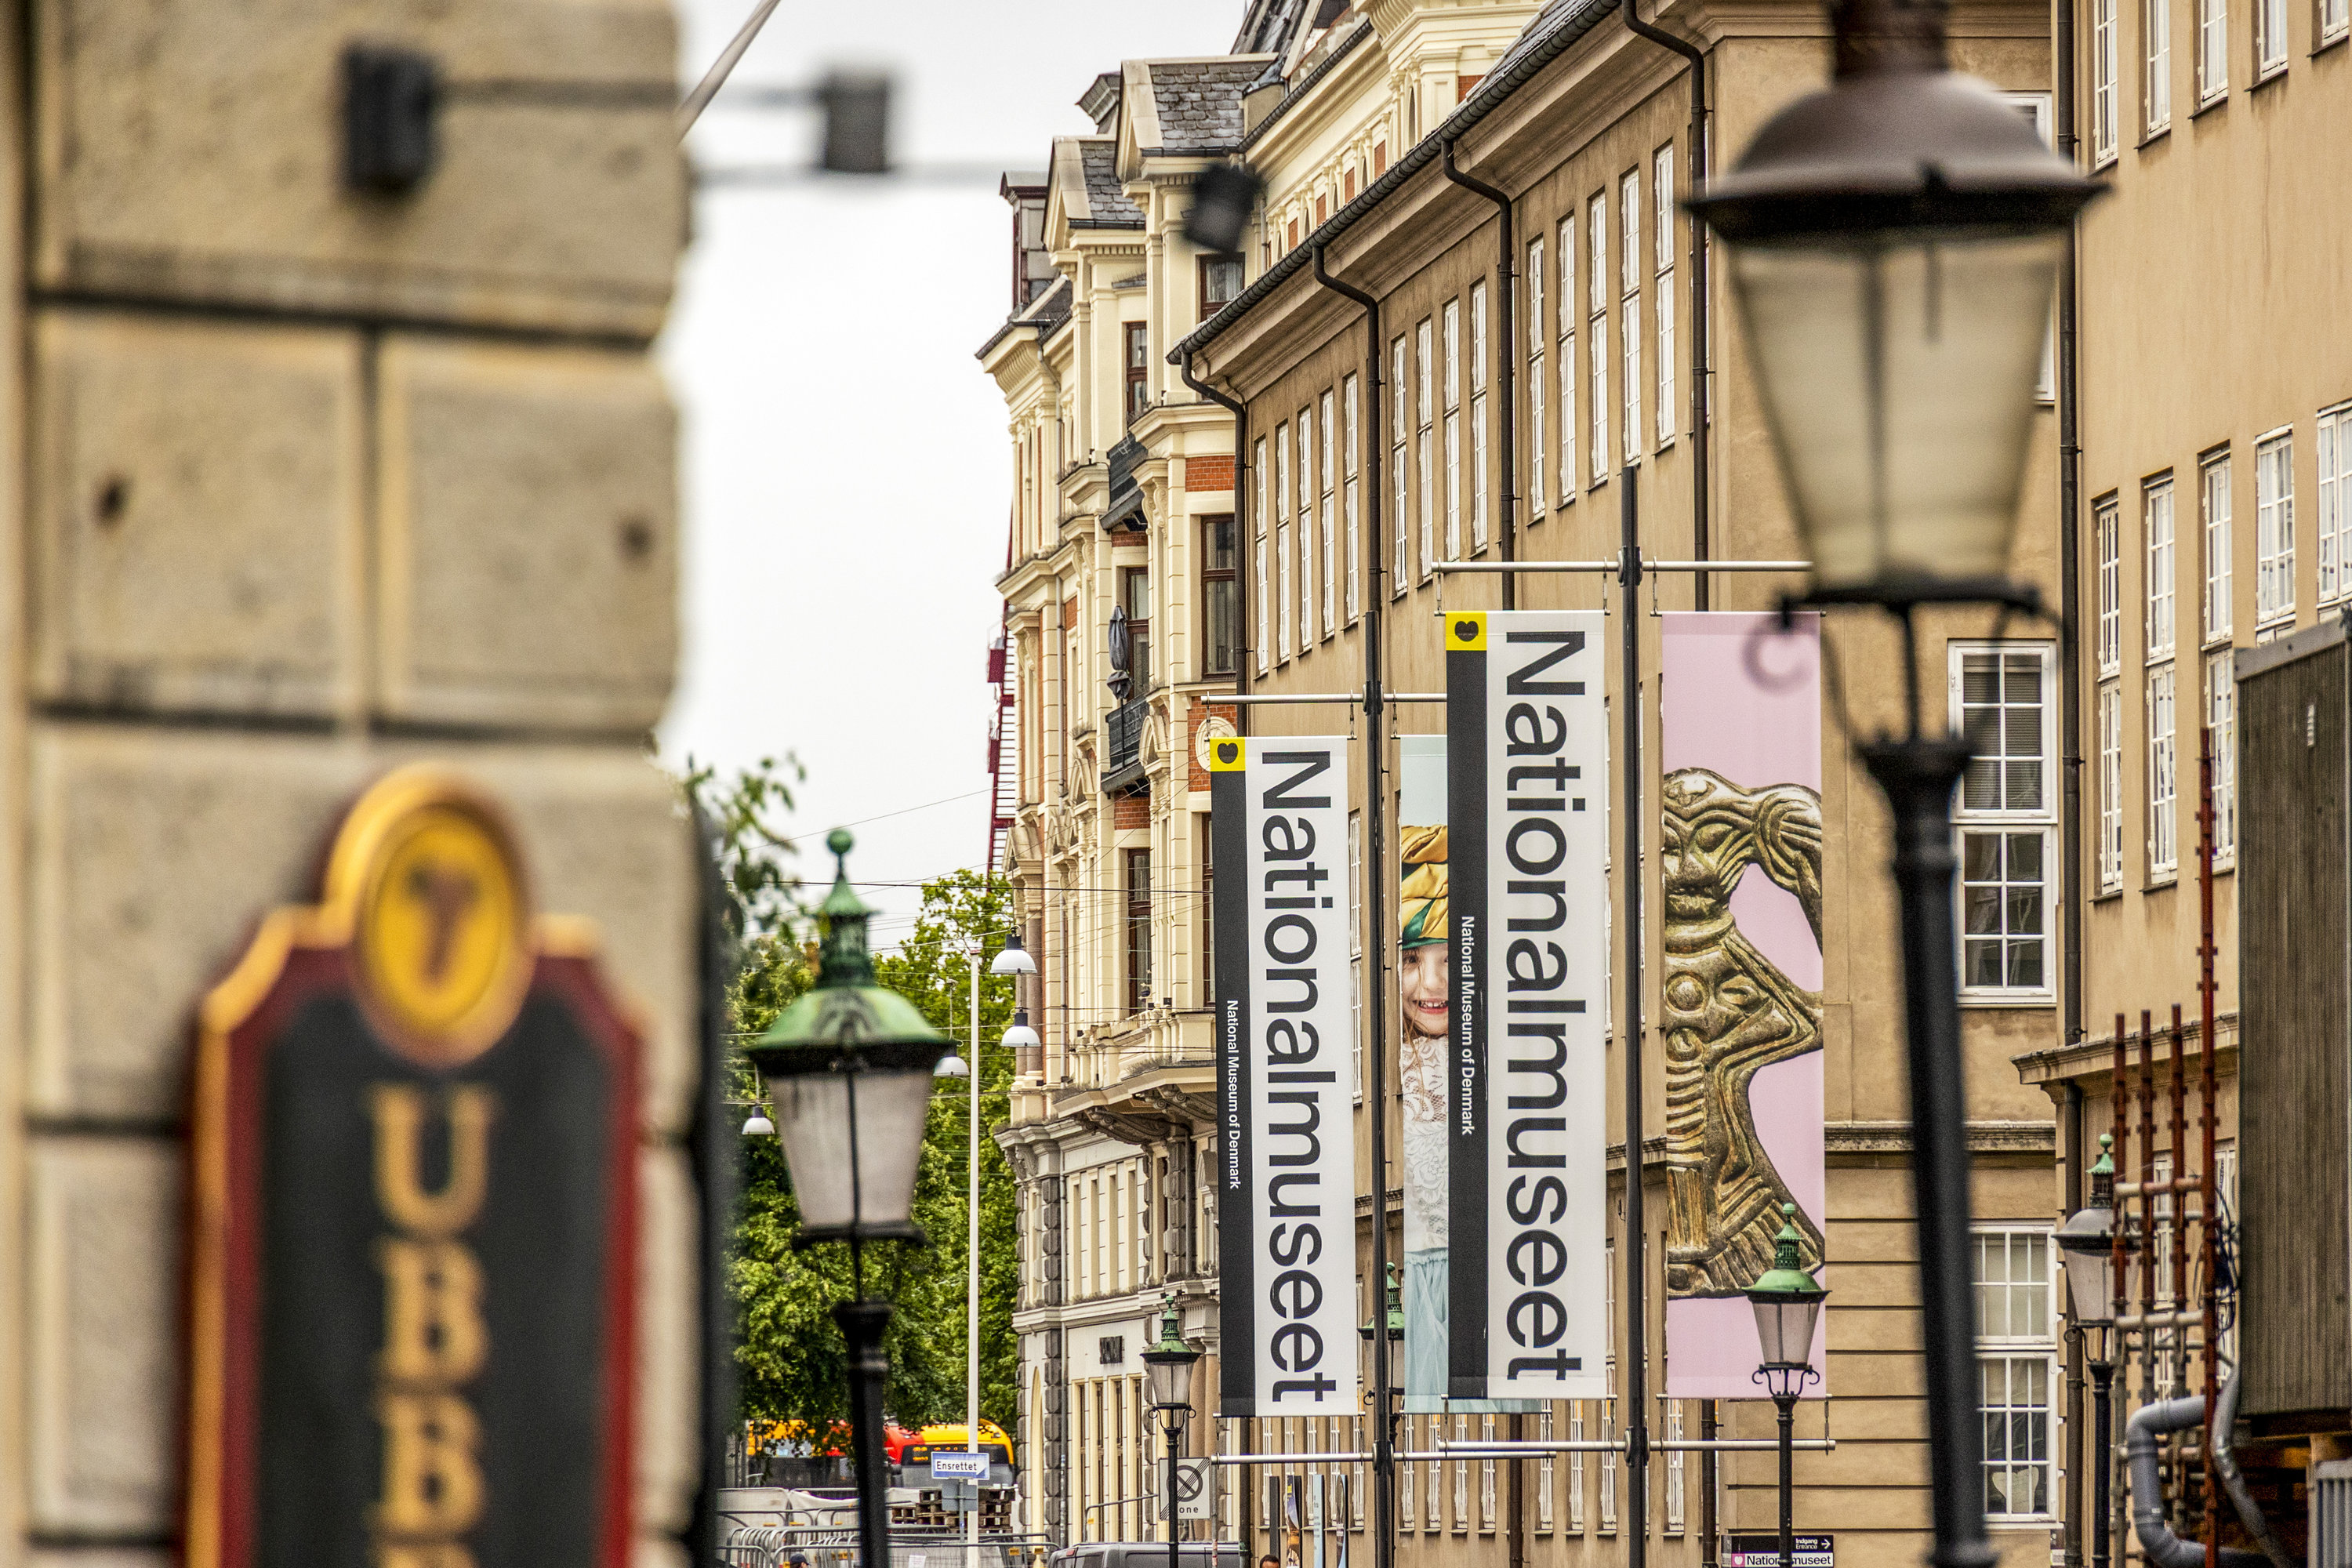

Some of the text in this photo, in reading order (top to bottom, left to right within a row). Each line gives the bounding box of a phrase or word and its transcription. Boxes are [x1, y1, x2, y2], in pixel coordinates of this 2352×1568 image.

[1226, 1000, 1241, 1189] National Museum of Denmark
[1261, 750, 1337, 1403] Nationalmuseet
[1461, 916, 1475, 1135] National Museum of Denmark
[1505, 630, 1586, 1381] Nationalmuseet
[367, 1080, 499, 1568] UBB
[936, 1461, 978, 1471] Ensrettet
[1747, 1555, 1831, 1566] Nationmuseet
